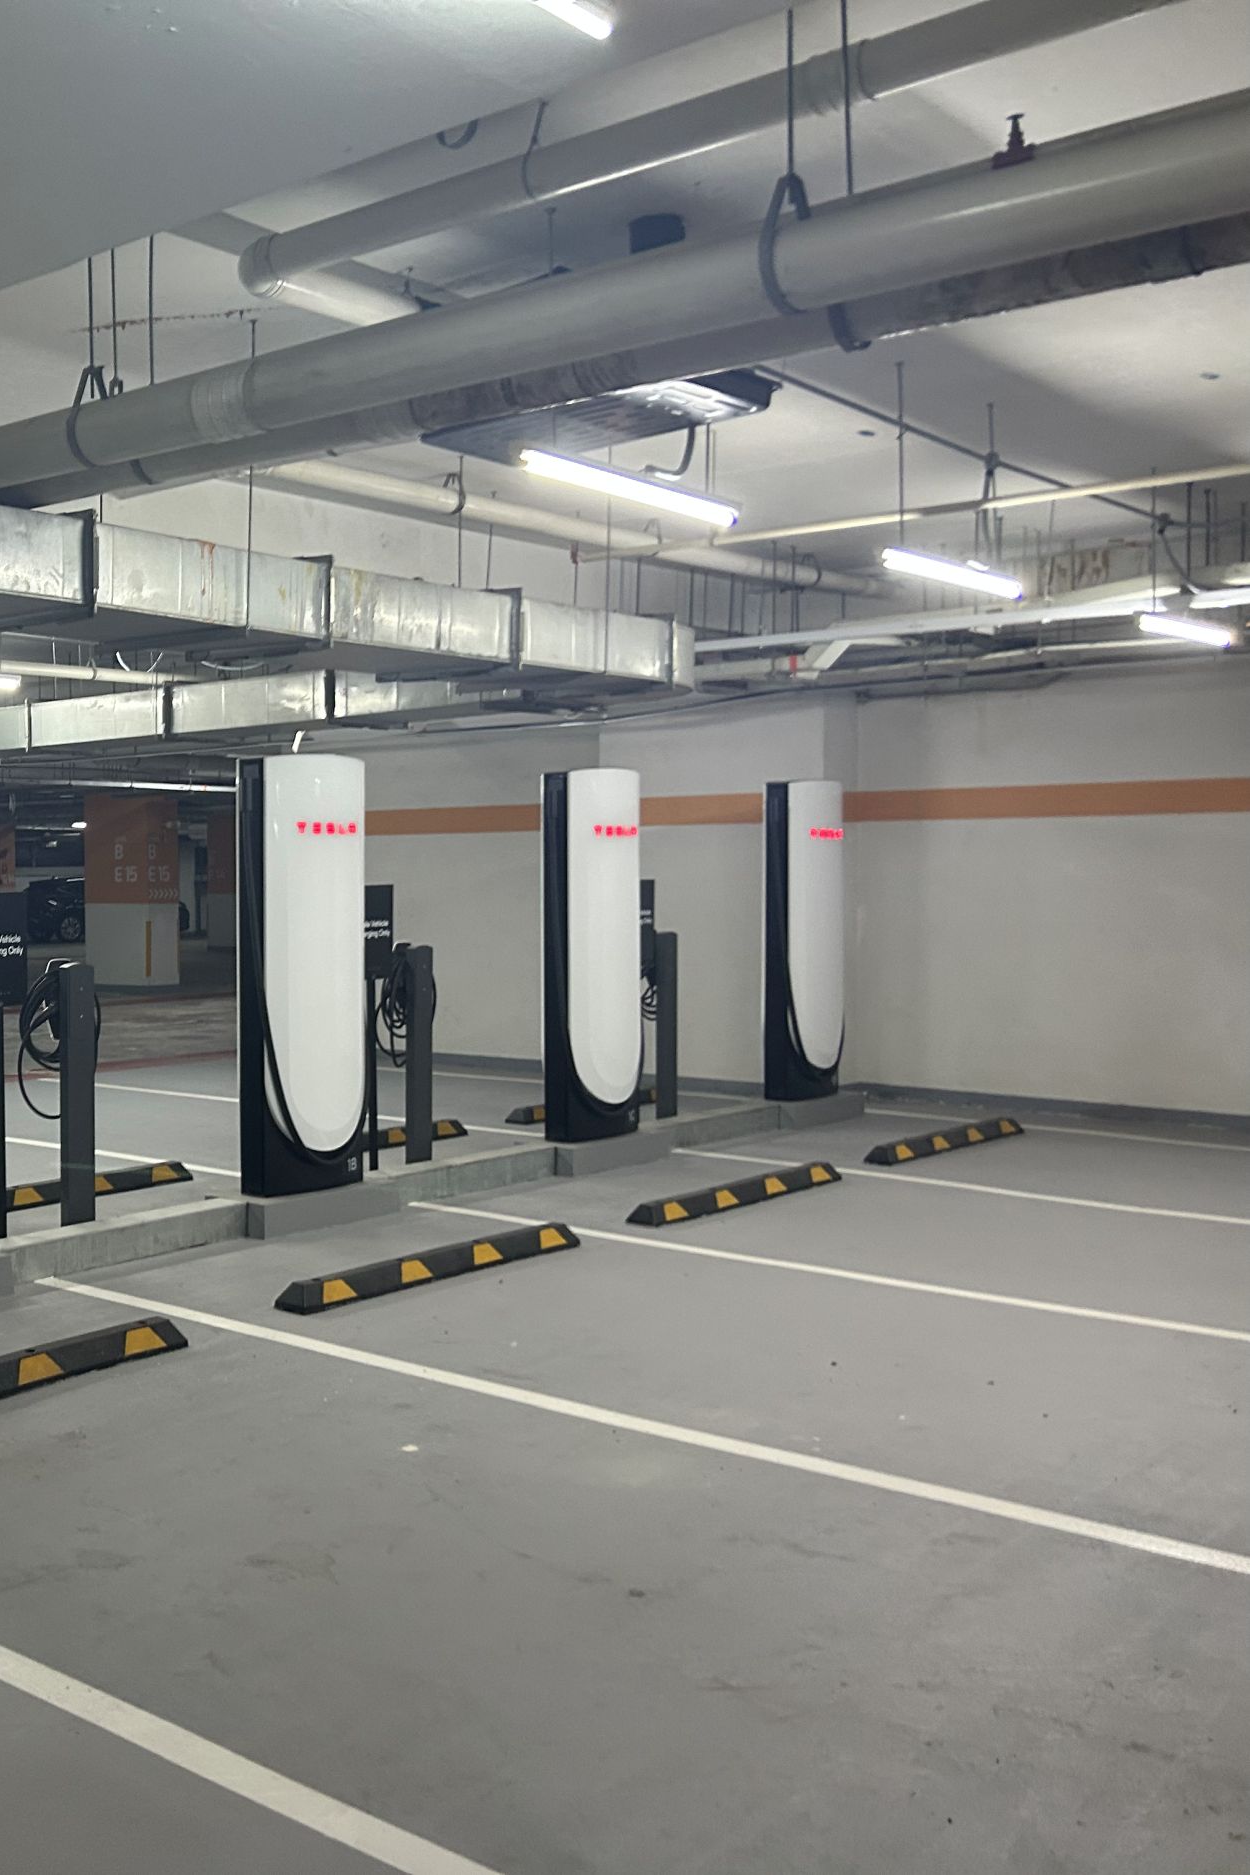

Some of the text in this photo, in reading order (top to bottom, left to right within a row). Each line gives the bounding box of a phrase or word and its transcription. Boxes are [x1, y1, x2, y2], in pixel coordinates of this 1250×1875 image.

[295, 820, 357, 835] TESLA
[114, 843, 124, 860] B
[148, 843, 157, 860] B
[7, 945, 24, 956] Only
